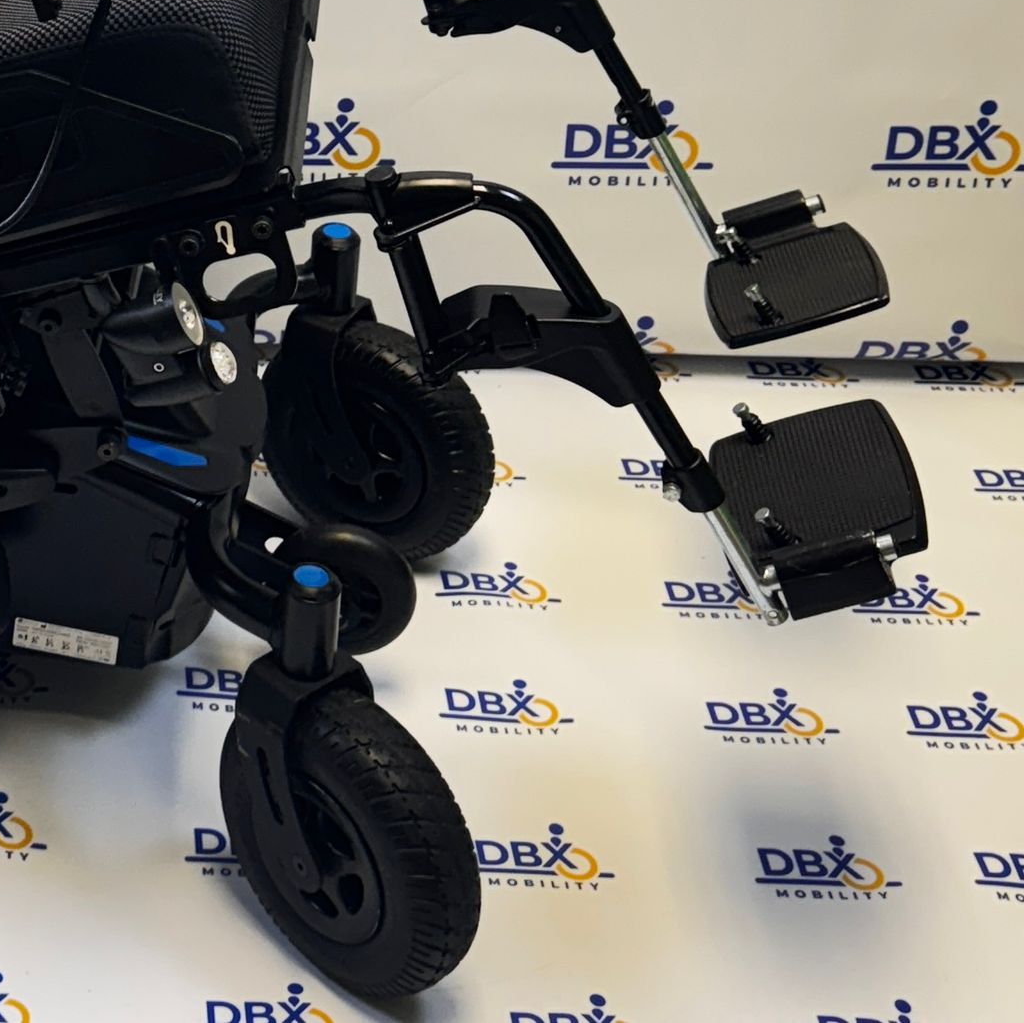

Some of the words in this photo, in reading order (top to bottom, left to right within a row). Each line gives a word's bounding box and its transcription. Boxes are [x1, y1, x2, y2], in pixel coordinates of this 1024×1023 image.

[303, 121, 360, 155] BX
[886, 125, 1000, 160] DBX
[568, 176, 672, 186] MOBILIT
[888, 177, 1011, 188] MOBILITY
[973, 469, 1024, 487] DB
[440, 570, 530, 595] DBX
[452, 600, 548, 610] MOBILITY
[870, 617, 967, 625] MOBILITY
[185, 667, 242, 693] DB
[445, 688, 538, 717] DBX
[707, 701, 799, 730] DBX
[907, 706, 1006, 732] DBX
[457, 724, 558, 735] MOBILITY
[723, 735, 826, 745] MOBILITY
[926, 741, 1024, 751] MOBILIT
[475, 841, 578, 869] DBX
[757, 846, 864, 879] DBX
[488, 878, 599, 891] MOBILITY
[776, 889, 886, 900] MOBILITY
